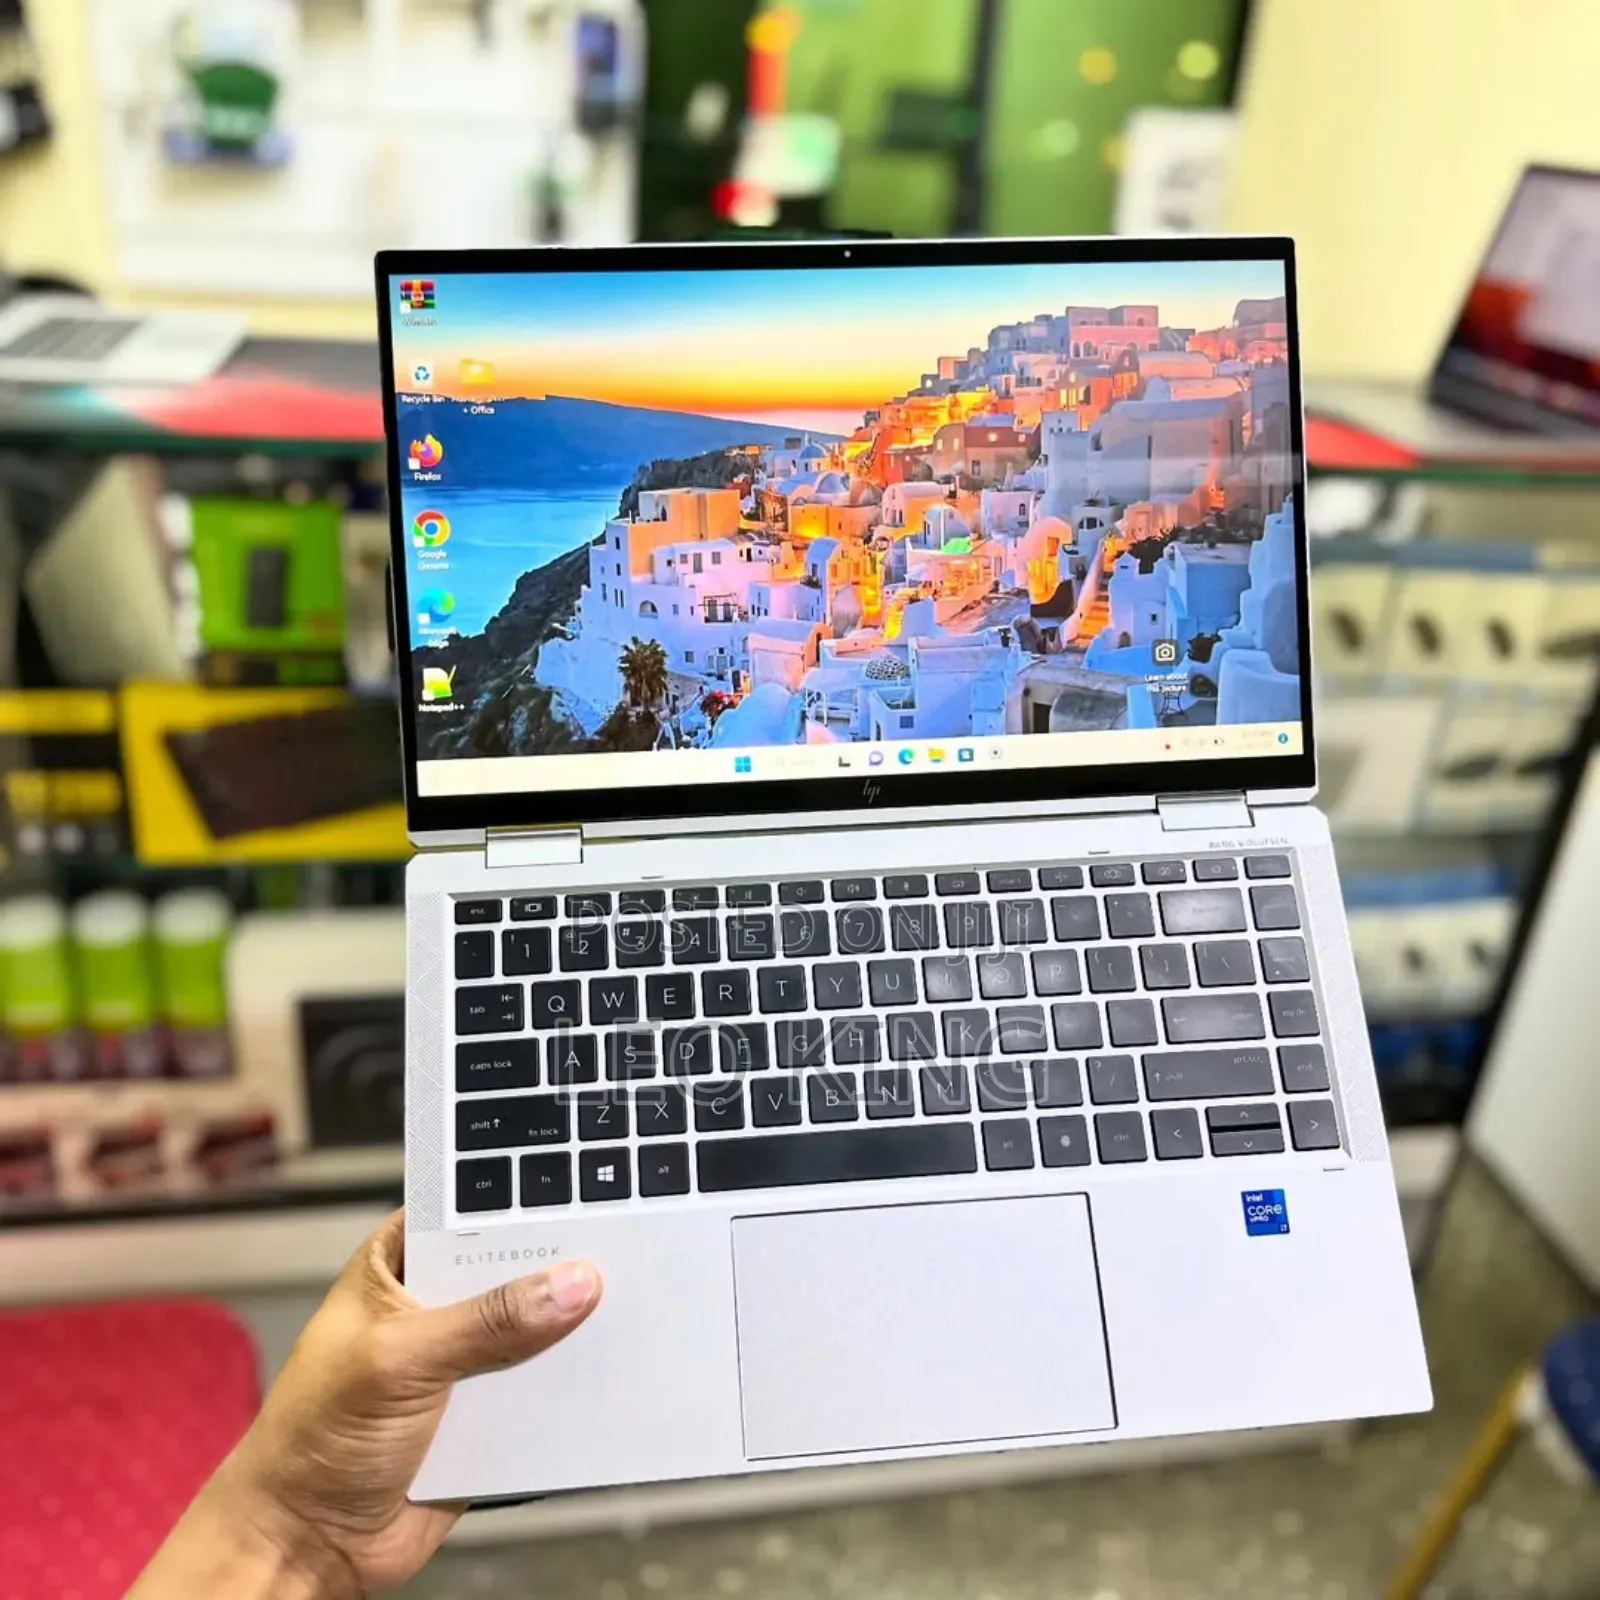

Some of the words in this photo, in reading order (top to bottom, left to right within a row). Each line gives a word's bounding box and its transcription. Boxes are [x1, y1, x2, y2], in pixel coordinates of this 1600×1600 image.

[414, 471, 442, 481] Firefox
[745, 930, 757, 943] 5
[855, 922, 865, 937] 7
[579, 940, 589, 954] 2
[635, 935, 645, 950] 3
[690, 933, 700, 947] 4
[775, 980, 788, 997] T
[829, 976, 844, 993] Y
[885, 973, 900, 990] U
[602, 991, 625, 1008] W
[663, 987, 677, 1005] E
[719, 984, 733, 1000] R
[469, 1006, 486, 1014] tab
[547, 995, 565, 1012] Q
[848, 1031, 863, 1048] H
[960, 1024, 974, 1041] K
[679, 1042, 694, 1060] D
[737, 1038, 750, 1056] F
[792, 1035, 808, 1052] G
[564, 1050, 581, 1068] A
[624, 1045, 637, 1063] S
[470, 1061, 491, 1071] caps
[493, 1060, 513, 1069] lock
[825, 1089, 839, 1106] B
[881, 1084, 897, 1101] N
[937, 1081, 954, 1099] M
[654, 1101, 669, 1119] X
[711, 1097, 727, 1115] C
[768, 1093, 783, 1110] V
[597, 1105, 610, 1124] Z
[470, 1119, 491, 1130] shift
[540, 1127, 559, 1136] lock
[657, 1164, 670, 1174] alt
[475, 1180, 493, 1189] ctrl
[541, 1175, 551, 1184] fn
[1245, 1193, 1263, 1202] intel
[455, 1245, 560, 1265] ELITEBOOK
